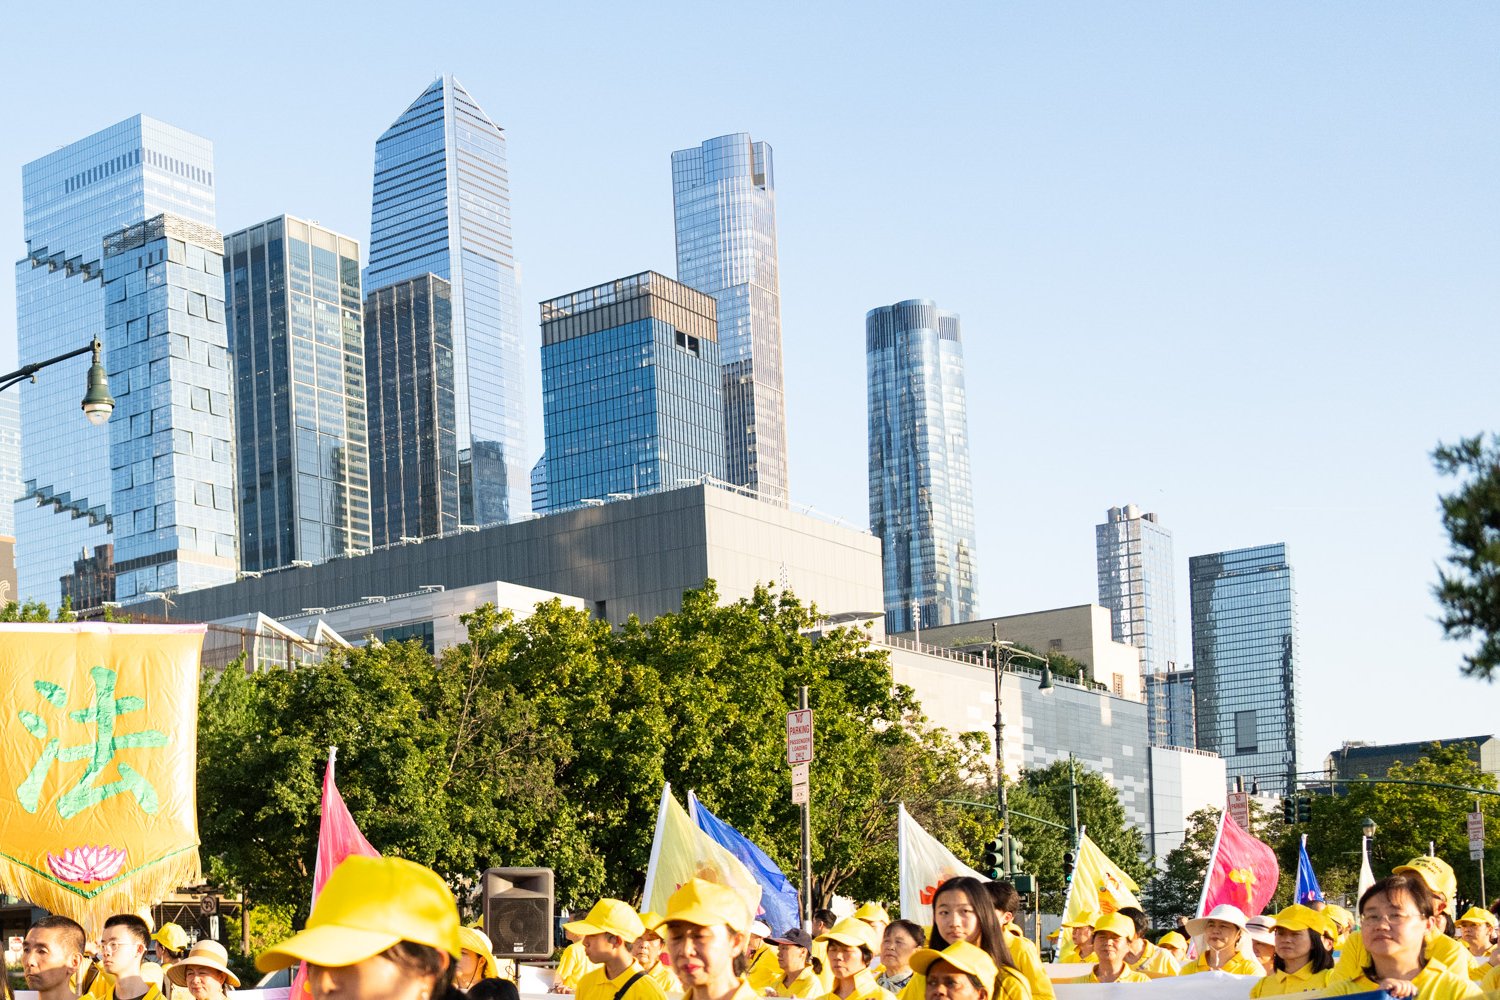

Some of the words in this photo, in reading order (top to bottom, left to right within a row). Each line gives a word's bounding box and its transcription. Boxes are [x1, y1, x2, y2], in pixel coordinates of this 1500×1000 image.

[795, 714, 803, 724] NO
[789, 725, 810, 736] PARKING
[17, 666, 170, 819] 法
